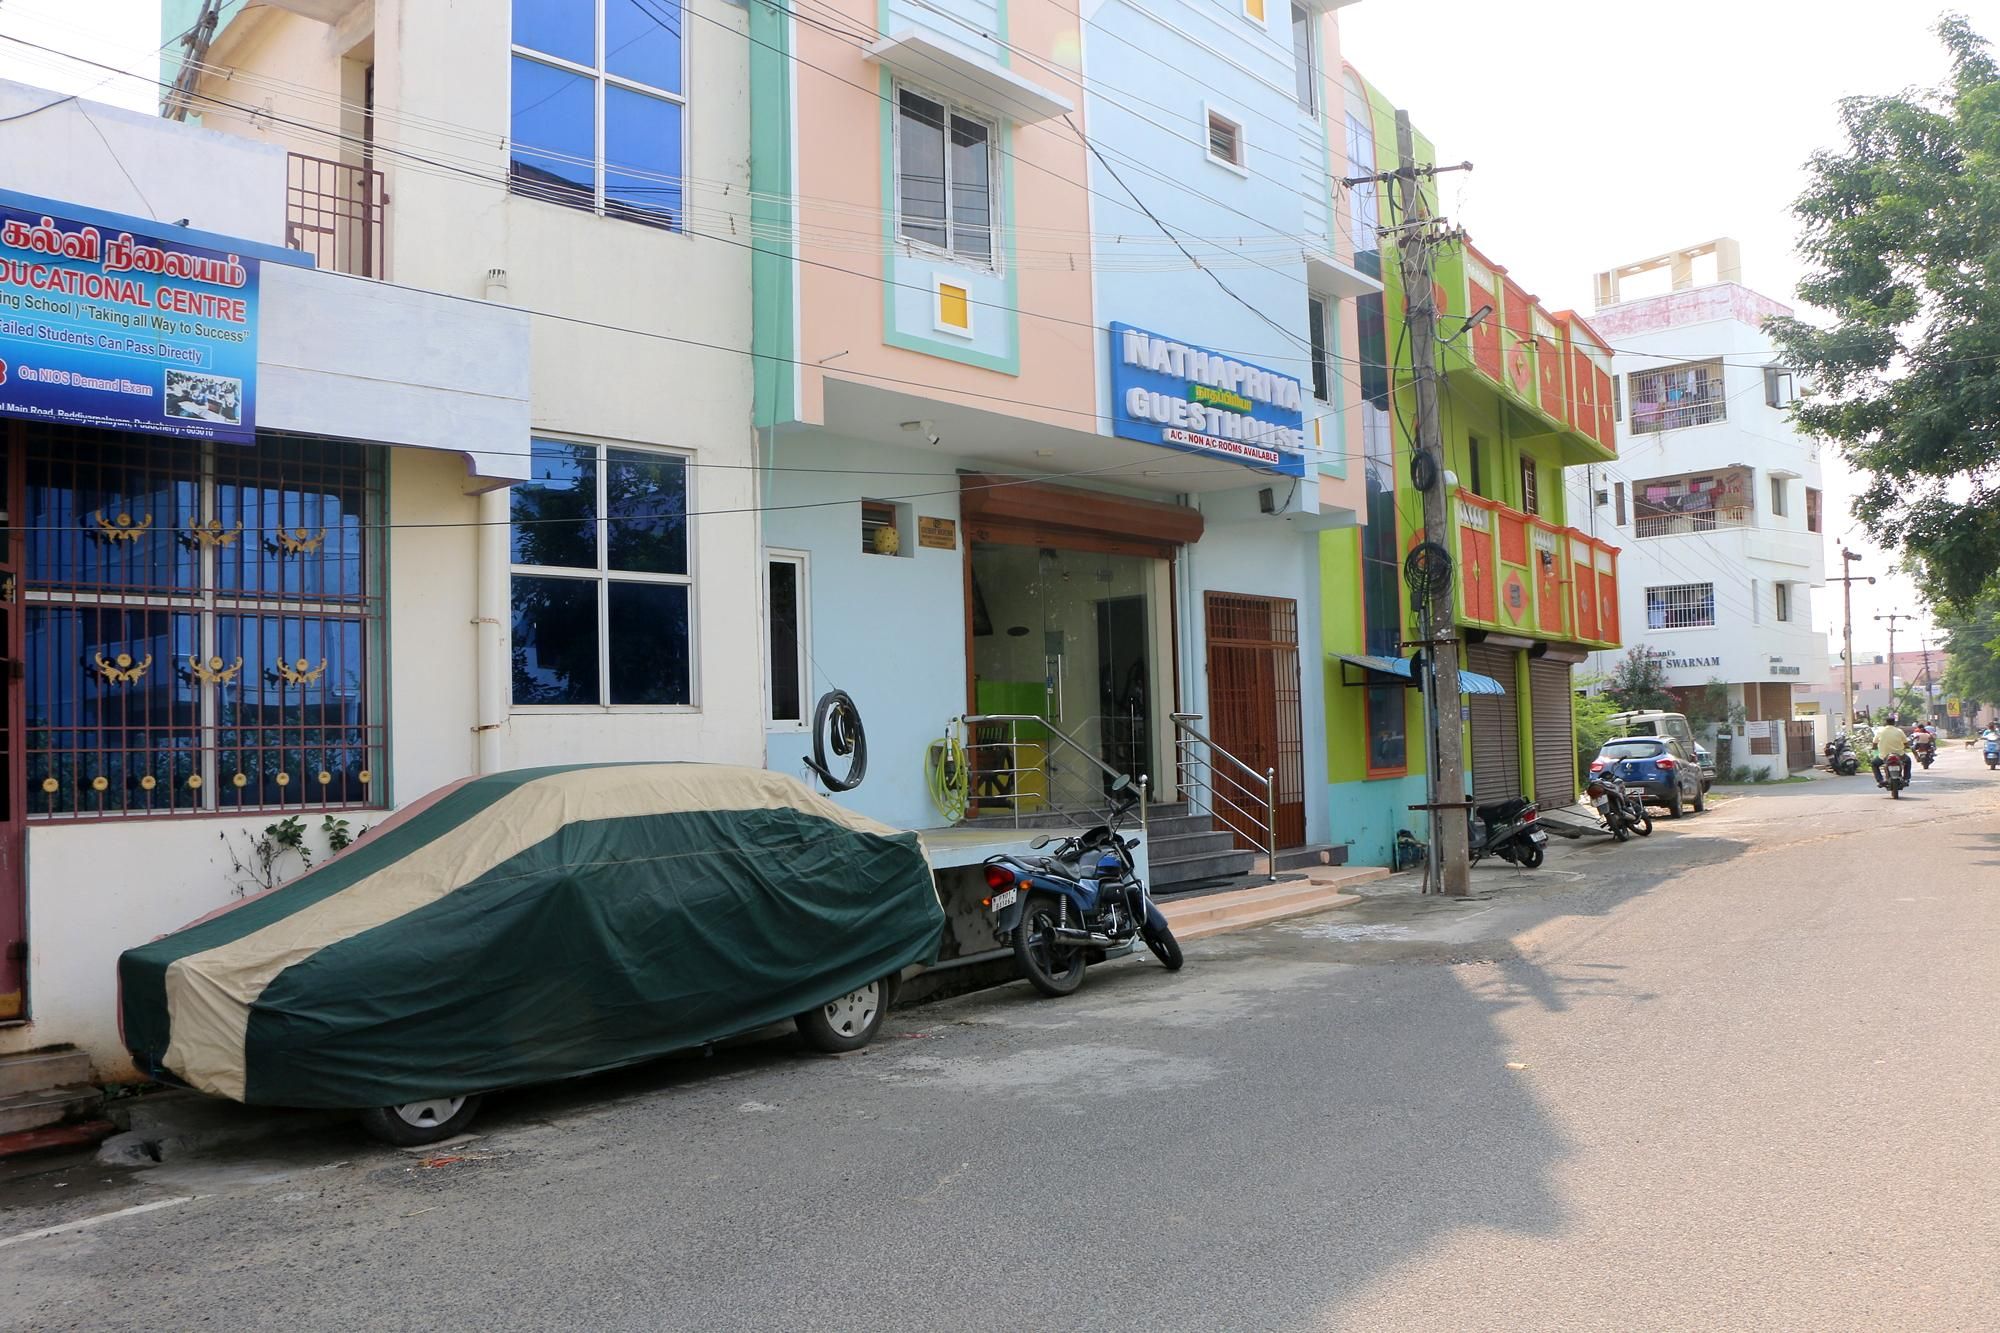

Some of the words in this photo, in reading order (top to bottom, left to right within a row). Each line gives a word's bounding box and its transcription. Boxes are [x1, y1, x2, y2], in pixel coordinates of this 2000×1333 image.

[2, 216, 99, 262] கல்வி
[103, 233, 246, 288] நிலையம்
[25, 294, 71, 316] School
[133, 314, 147, 327] all
[151, 315, 177, 335] Way
[180, 322, 192, 334] to
[156, 286, 246, 323] CENTRE
[0, 319, 34, 338] ailed
[38, 325, 95, 346] Students
[98, 335, 123, 350] Can
[126, 338, 155, 355] Pass
[158, 343, 202, 365] Directly
[18, 365, 38, 381] On
[39, 368, 71, 385] NIOS
[72, 372, 120, 392] Demand
[121, 379, 153, 397] Exam
[1123, 329, 1303, 412] NATHAPRIYA
[6, 403, 28, 413] Main
[1126, 387, 1304, 457] GUESTHOUSE
[1170, 429, 1183, 440] A/C
[1188, 432, 1204, 445] NON
[1205, 437, 1218, 449] A/C
[1218, 441, 1242, 454] ROOMS
[1243, 447, 1278, 463] AVAILABLE
[1666, 656, 1720, 669] SWARNAM
